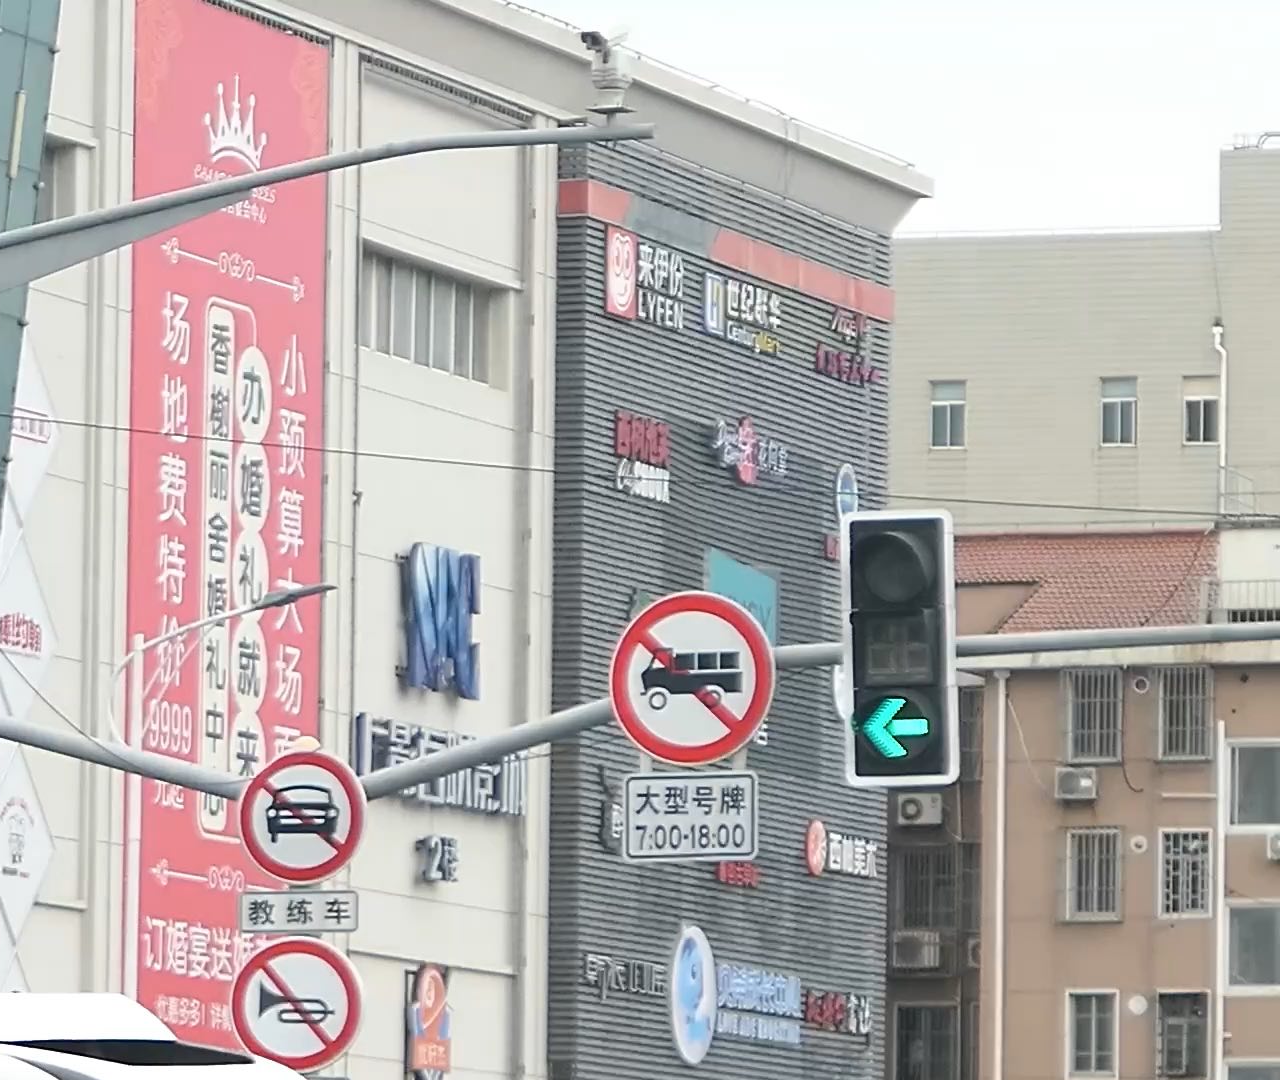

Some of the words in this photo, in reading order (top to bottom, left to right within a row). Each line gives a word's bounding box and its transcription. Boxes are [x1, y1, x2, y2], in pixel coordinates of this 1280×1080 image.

[639, 244, 684, 297] 来伊份
[639, 288, 684, 329] LYFEN
[149, 699, 192, 754] 9999
[635, 785, 746, 816] 大型号牌
[635, 824, 746, 850] 7:00-18:00
[248, 898, 352, 926] 教练车
